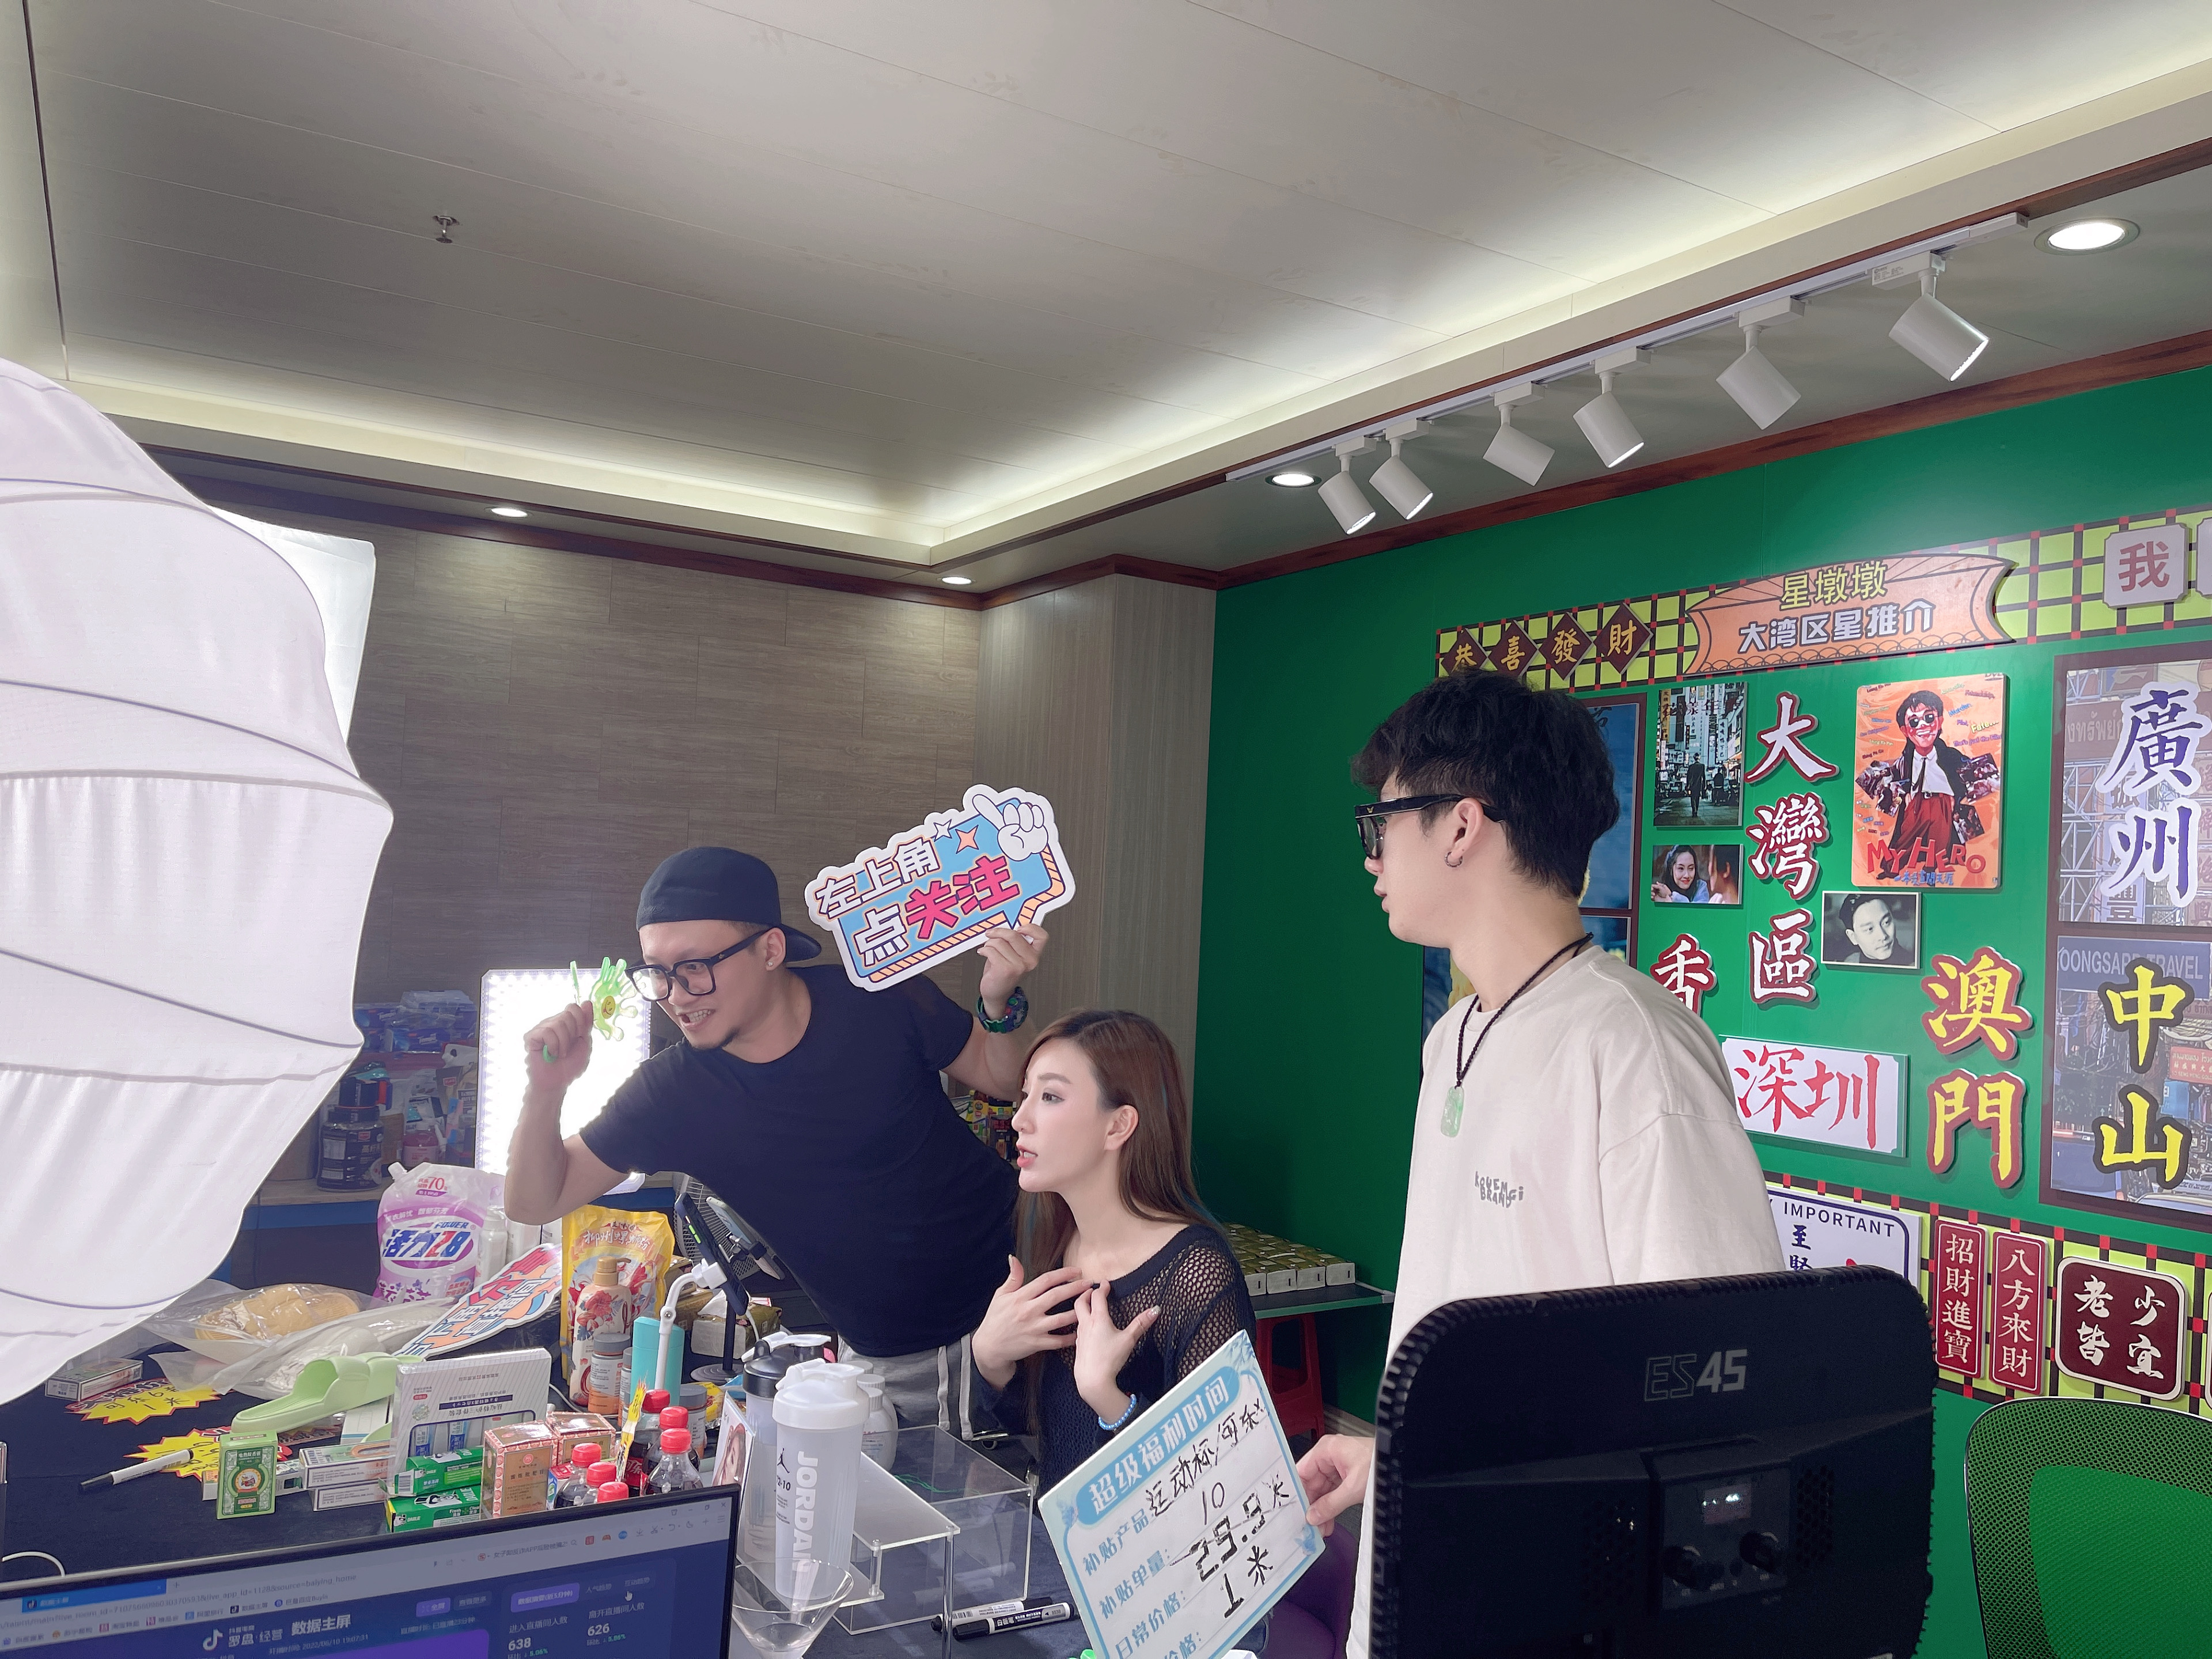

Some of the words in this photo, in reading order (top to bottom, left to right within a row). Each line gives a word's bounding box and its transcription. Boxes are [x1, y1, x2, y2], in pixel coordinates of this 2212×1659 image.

[1781, 560, 1888, 611] 星墩墩
[2118, 541, 2170, 592] 我
[1738, 599, 1936, 653] 大湾区星推介
[2104, 690, 2203, 899] 廣州
[1746, 692, 1835, 1000] 大灣區
[1867, 839, 1906, 874] MY
[1907, 837, 1986, 874] HERO
[815, 836, 940, 919] 左上角
[853, 856, 1020, 967] 点关注
[1926, 952, 2024, 1182] 澳門
[2100, 965, 2186, 1181] 中山
[1734, 1044, 1878, 1149] 深圳
[1784, 1202, 1895, 1237] IMPORTANT
[1942, 1233, 1974, 1364] 招財進寶
[2000, 1248, 2034, 1378] 八方來財
[1644, 1349, 1748, 1402] ES45
[1089, 1375, 1229, 1514] 超级福利时间
[793, 1450, 818, 1572] JORDAN
[1202, 1482, 1225, 1526] 10
[291, 1613, 351, 1636] 数据主屏
[509, 1615, 568, 1634] 进入直播间人数
[588, 1601, 645, 1619] 离开直播间人数
[588, 1623, 611, 1637] 626
[508, 1637, 532, 1652] 638
